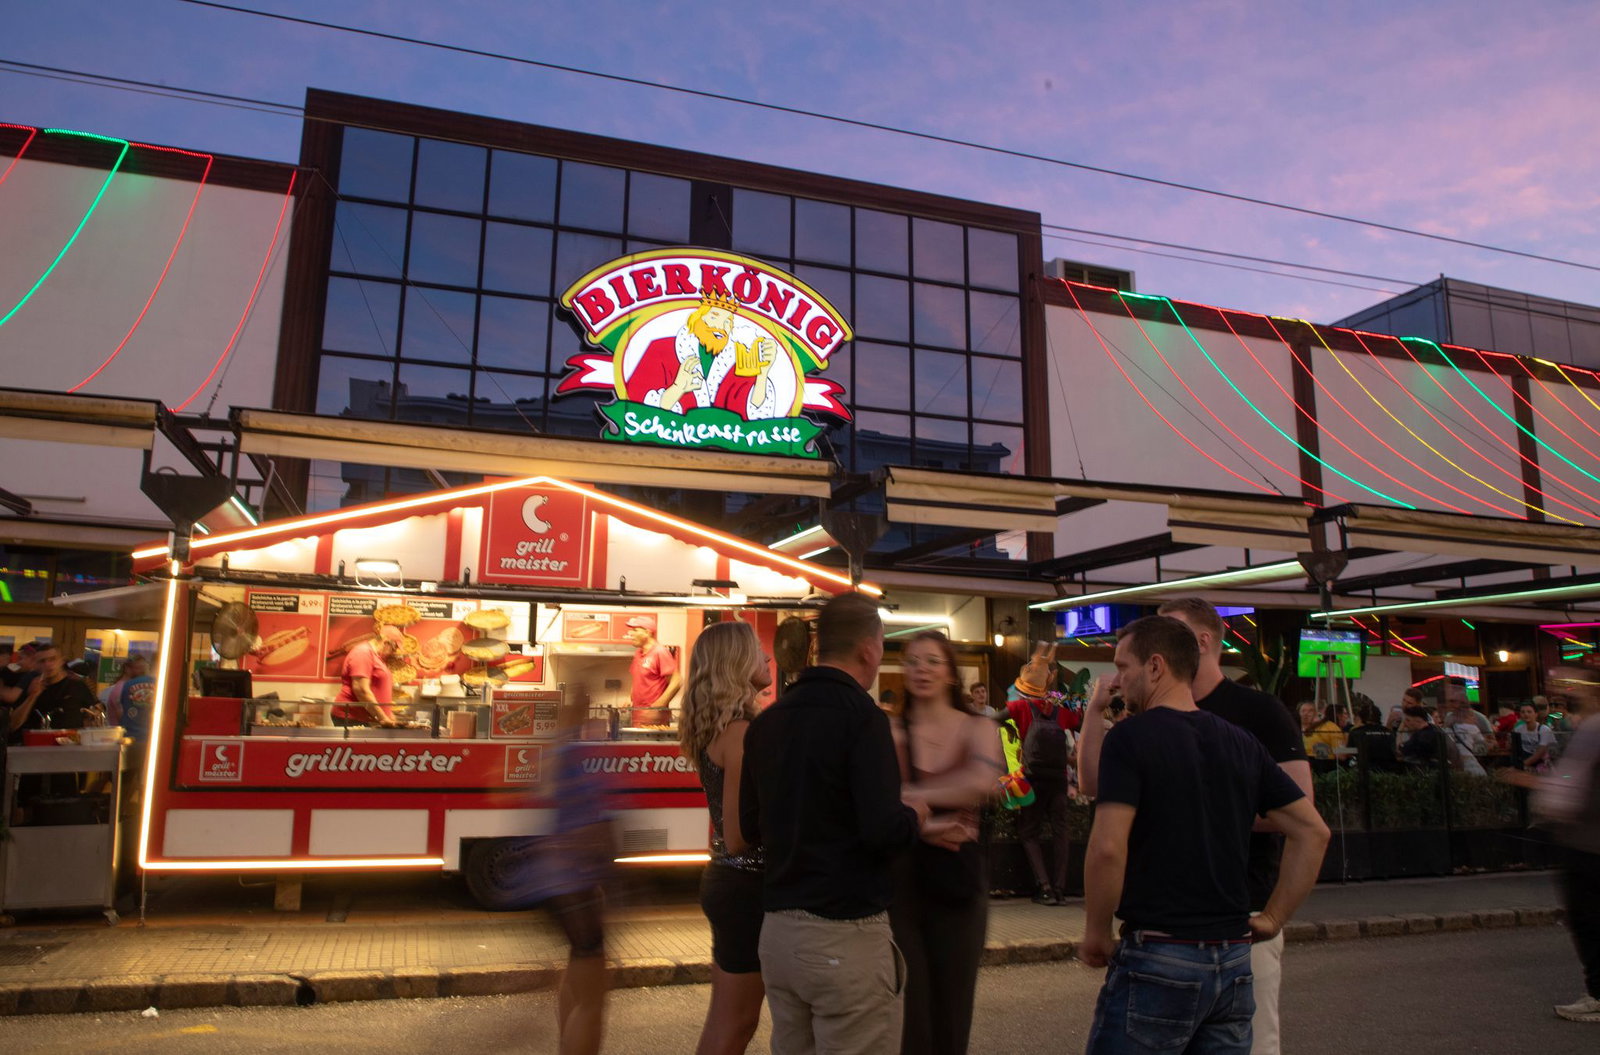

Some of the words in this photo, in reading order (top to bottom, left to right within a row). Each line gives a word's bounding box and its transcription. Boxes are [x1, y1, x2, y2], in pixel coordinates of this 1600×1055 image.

[574, 263, 838, 351] BIERKÖNIG
[624, 411, 801, 446] Schinkenstrasse
[516, 538, 555, 556] grill
[500, 555, 568, 571] meister
[212, 761, 230, 771] grill
[285, 747, 462, 777] grillmeister
[515, 763, 531, 773] grill
[582, 751, 697, 773] wurstme
